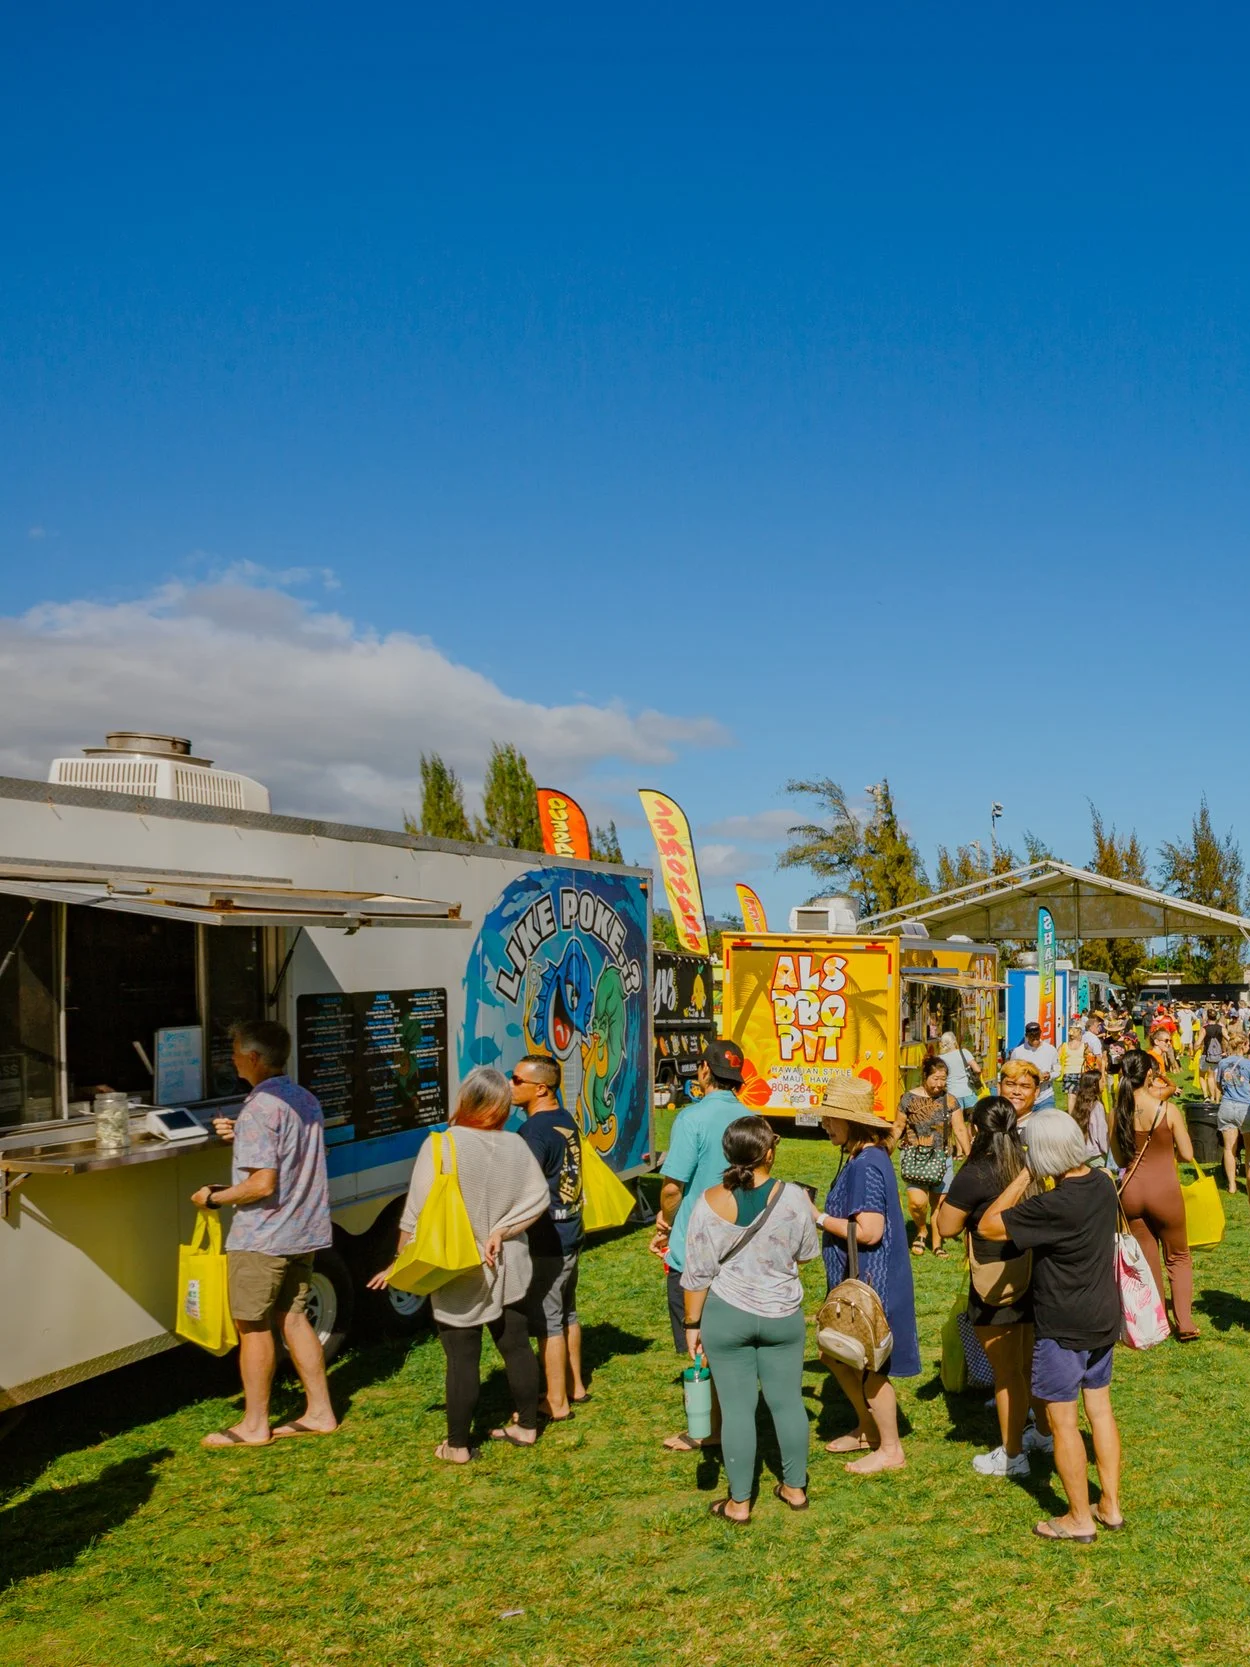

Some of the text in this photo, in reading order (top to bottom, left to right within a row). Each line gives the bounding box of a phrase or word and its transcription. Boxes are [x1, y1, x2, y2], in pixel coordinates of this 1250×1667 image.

[496, 892, 558, 1006] LIKE
[772, 955, 848, 992] ALS
[771, 989, 846, 1027] BBQ
[777, 1025, 842, 1062] PIT
[771, 1066, 852, 1077] HAWAIIAN STYLE
[771, 1083, 827, 1094] 808-264-36
[810, 1076, 830, 1084] HAW
